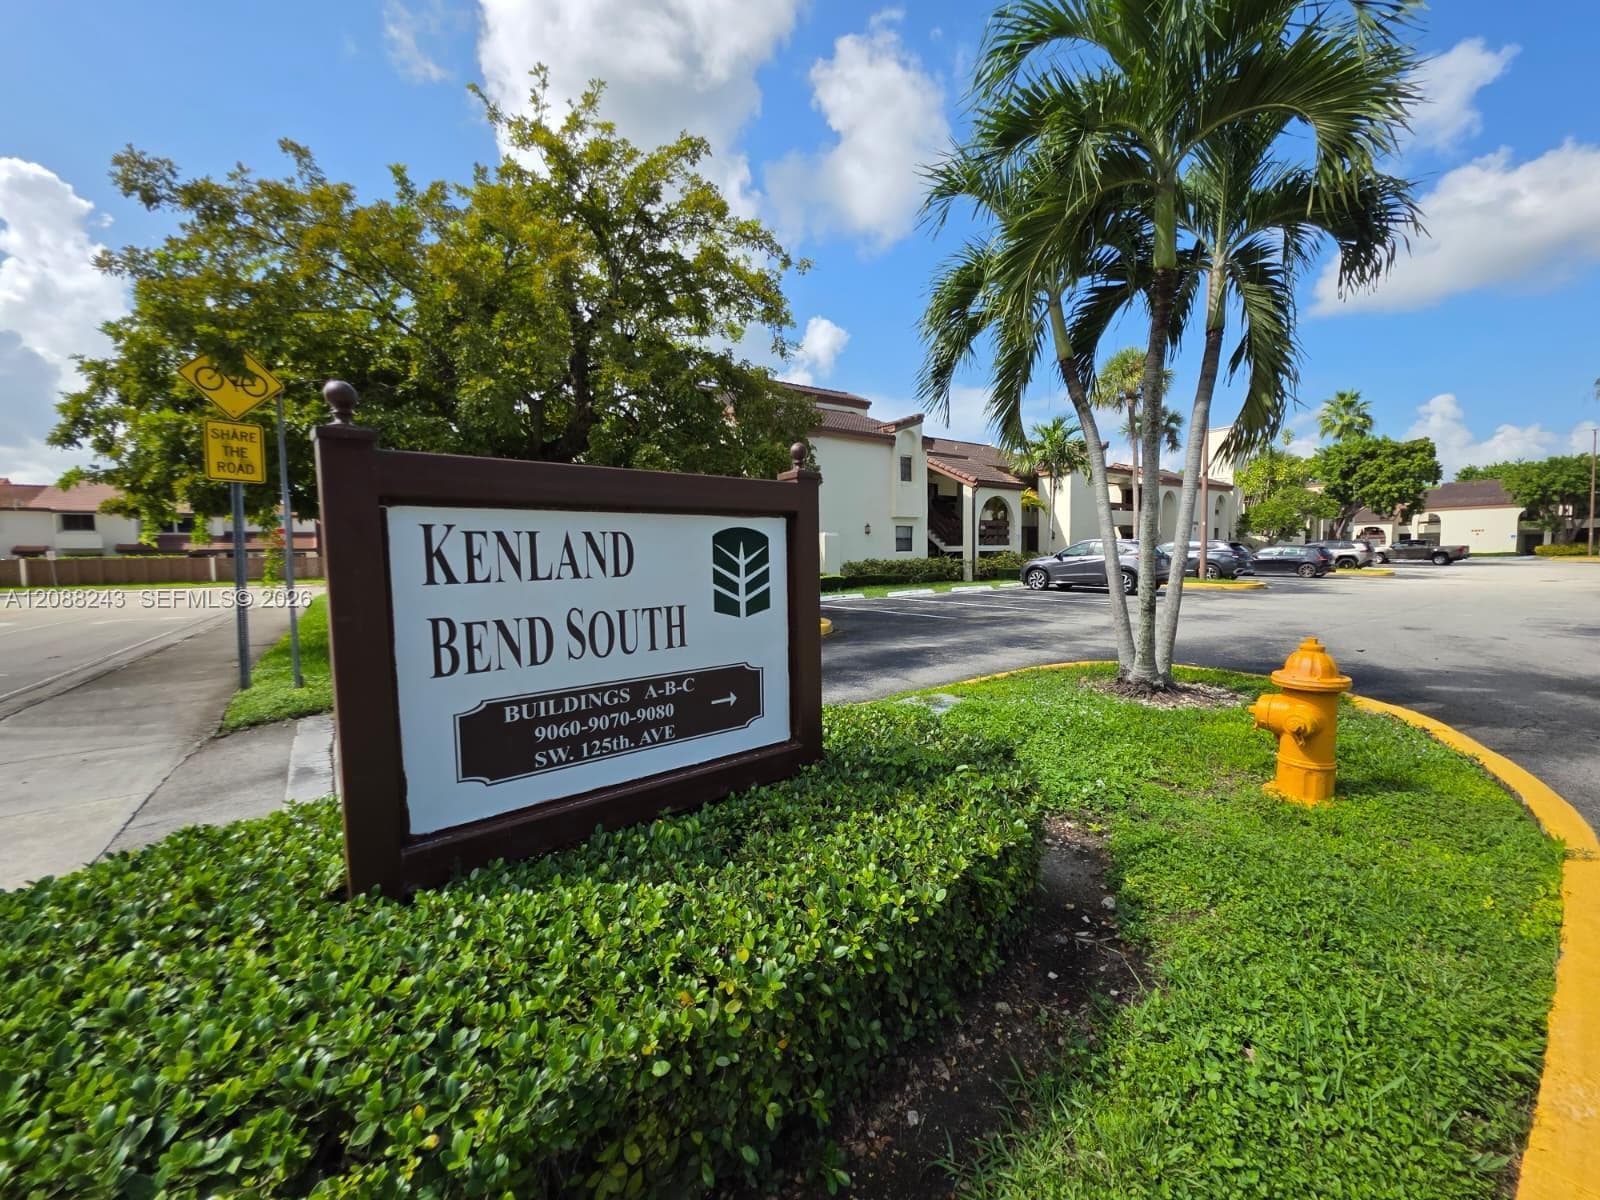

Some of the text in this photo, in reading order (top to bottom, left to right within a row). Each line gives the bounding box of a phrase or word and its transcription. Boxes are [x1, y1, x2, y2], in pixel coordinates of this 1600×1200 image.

[210, 428, 257, 443] SHARE
[222, 445, 249, 459] THE
[216, 461, 256, 475] ROAD
[503, 677, 696, 724] BUILDINGS A-B-C
[534, 702, 675, 743] 9060-9070-9080
[535, 723, 677, 768] SW. 125th. AVE
